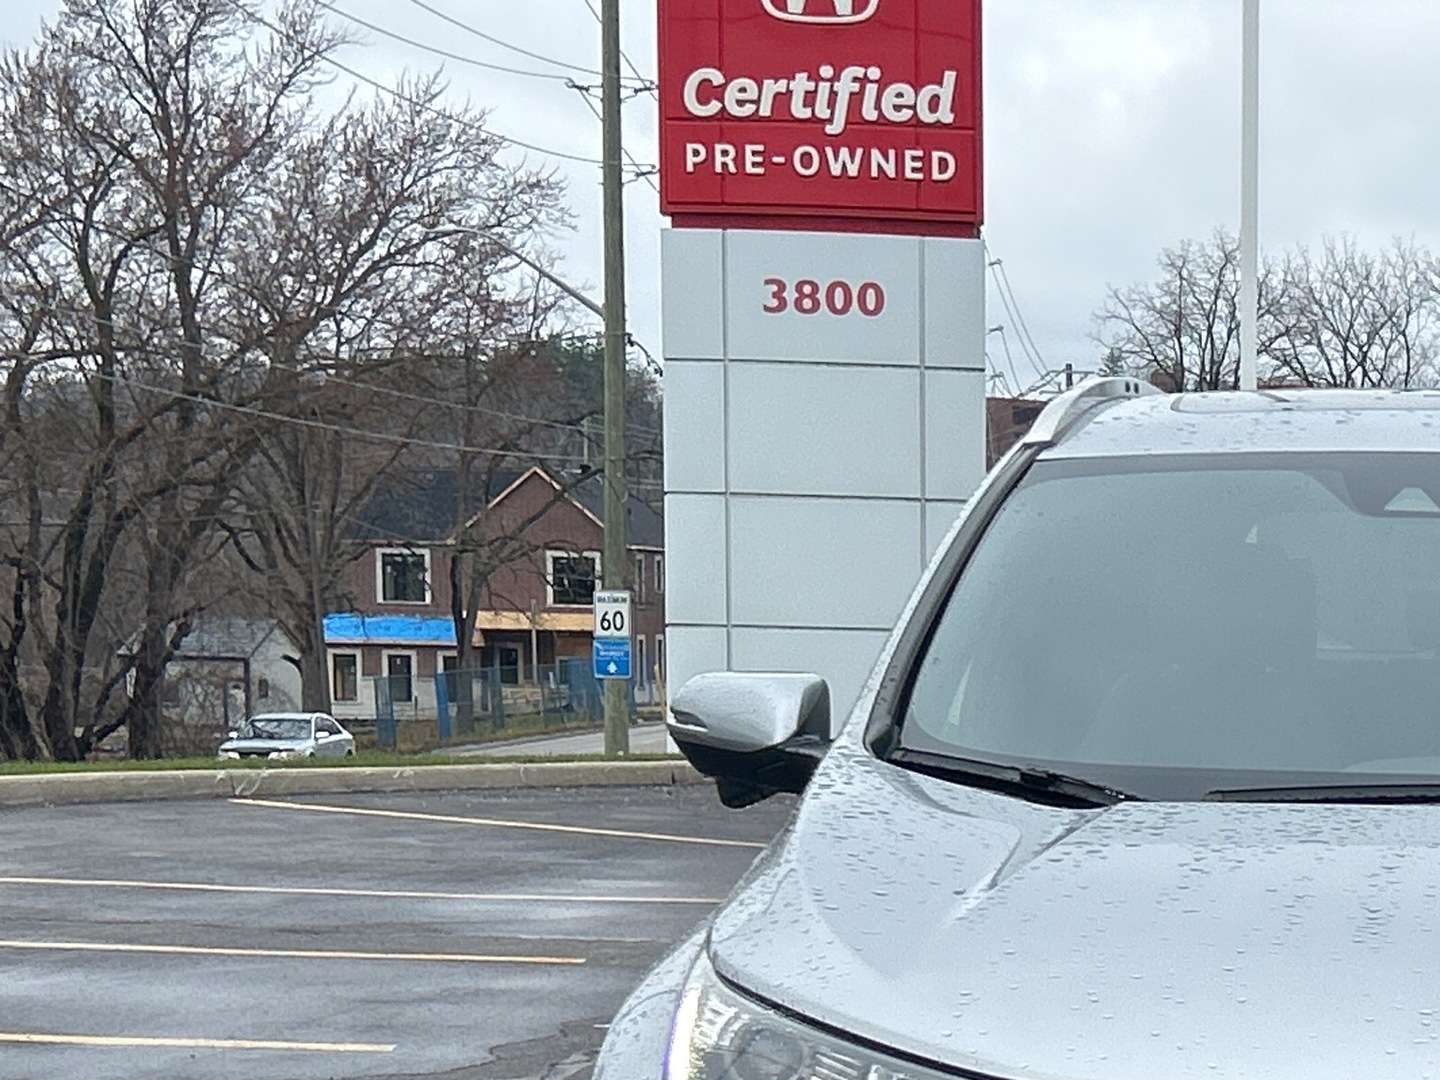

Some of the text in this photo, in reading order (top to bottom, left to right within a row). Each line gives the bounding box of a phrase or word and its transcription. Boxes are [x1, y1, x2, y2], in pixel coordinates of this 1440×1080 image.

[683, 65, 957, 135] Certified
[685, 143, 957, 181] PRE-OWNED
[762, 278, 886, 317] 3800
[600, 610, 624, 631] 60
